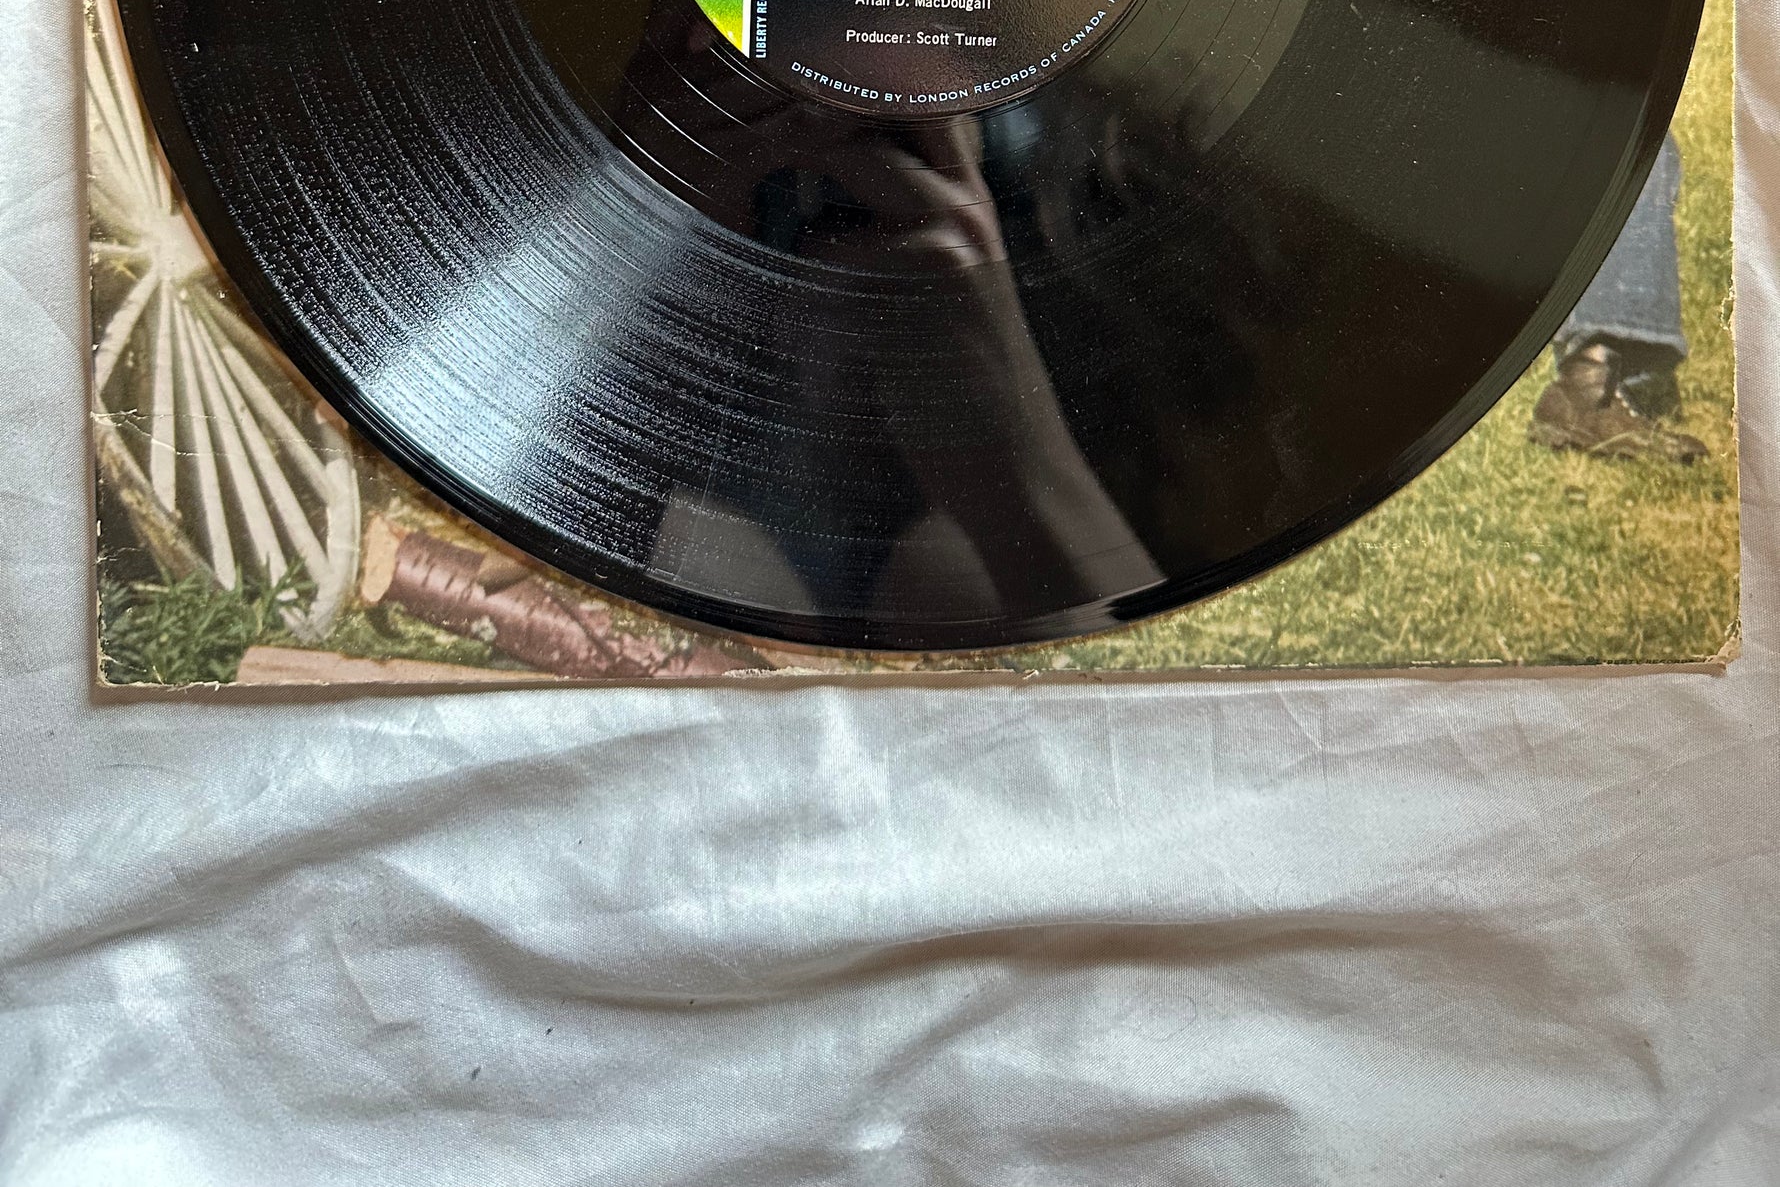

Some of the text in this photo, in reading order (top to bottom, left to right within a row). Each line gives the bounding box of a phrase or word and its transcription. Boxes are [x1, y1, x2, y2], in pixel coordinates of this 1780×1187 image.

[755, 17, 767, 59] LIBERTY
[791, 61, 879, 101] DISTRIBUTED
[884, 92, 903, 103] BY
[909, 88, 969, 104] LONDON
[973, 65, 1038, 95] RECORDS
[1040, 52, 1059, 68] OF
[1062, 9, 1107, 53] CANADA
[916, 31, 949, 45] Scott
[955, 33, 998, 47] Turner
